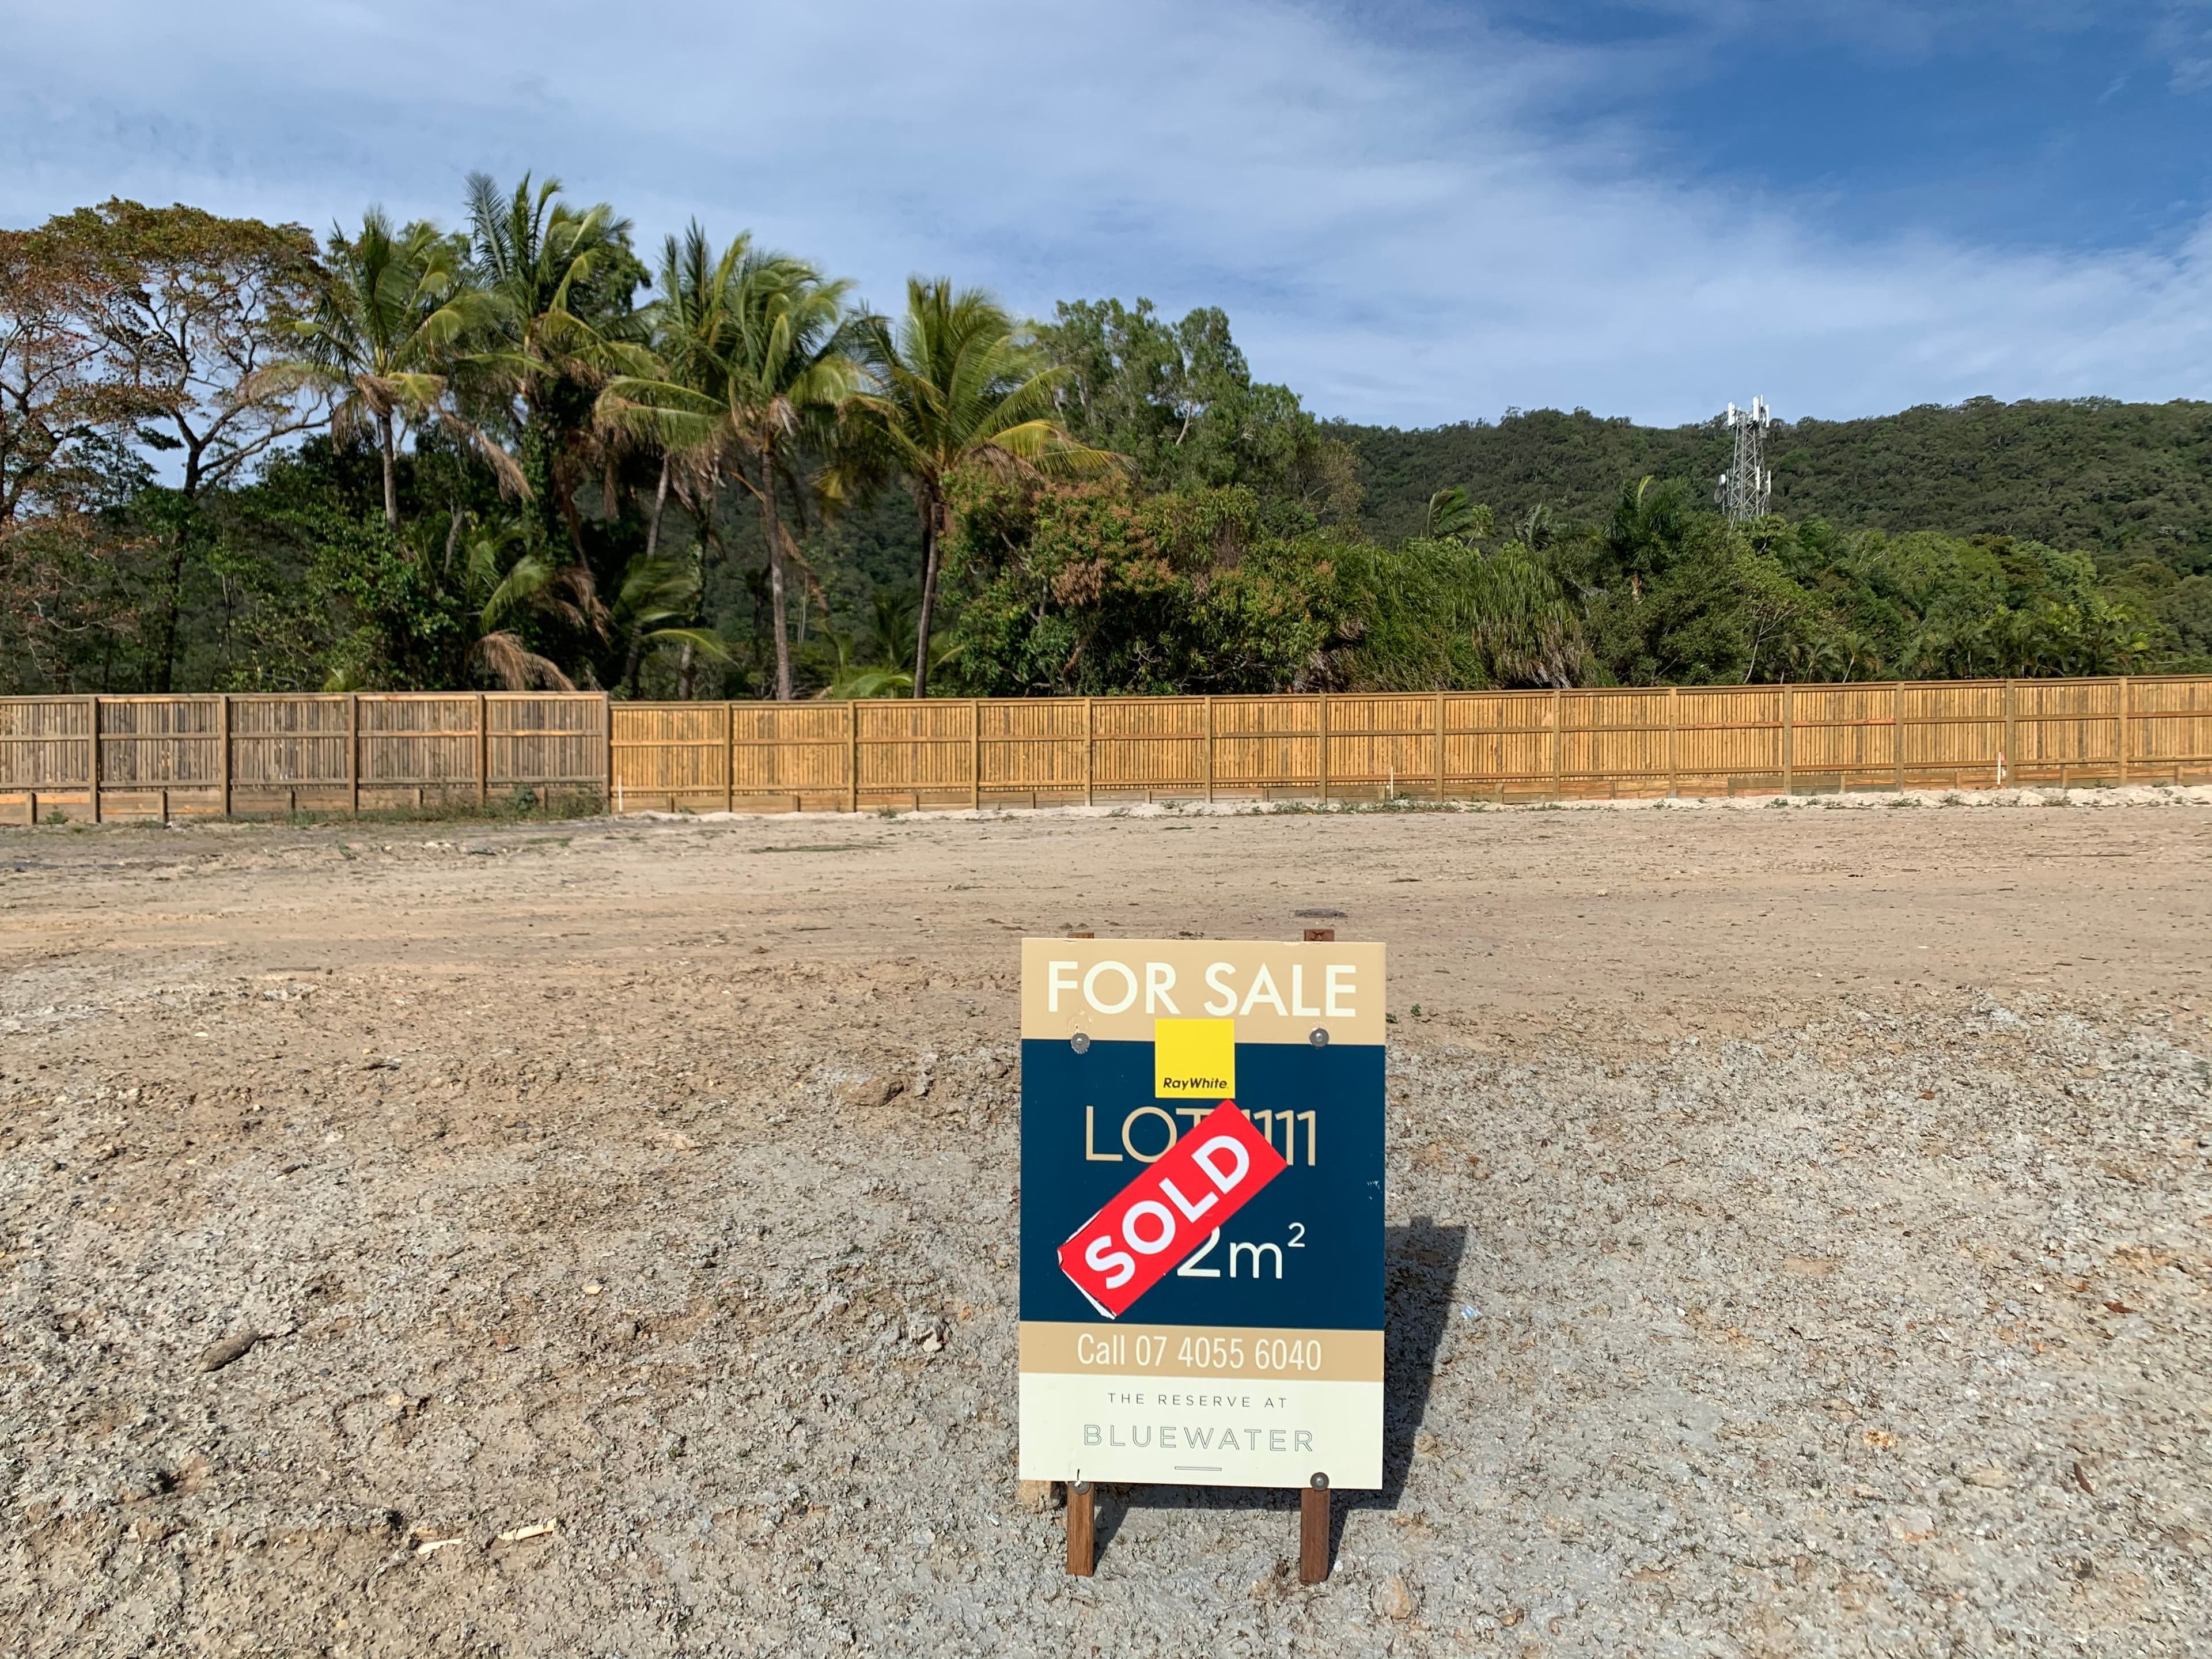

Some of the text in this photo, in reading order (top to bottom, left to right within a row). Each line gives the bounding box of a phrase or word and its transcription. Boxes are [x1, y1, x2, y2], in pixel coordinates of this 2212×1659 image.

[1048, 961, 1356, 1017] FOR SALE
[1085, 1135, 1250, 1289] SOLD
[1077, 1334, 1322, 1371] Call 07 4055 6040
[1108, 1392, 1287, 1408] THE RESERVE AT
[1084, 1425, 1313, 1452] BLUEWATER
